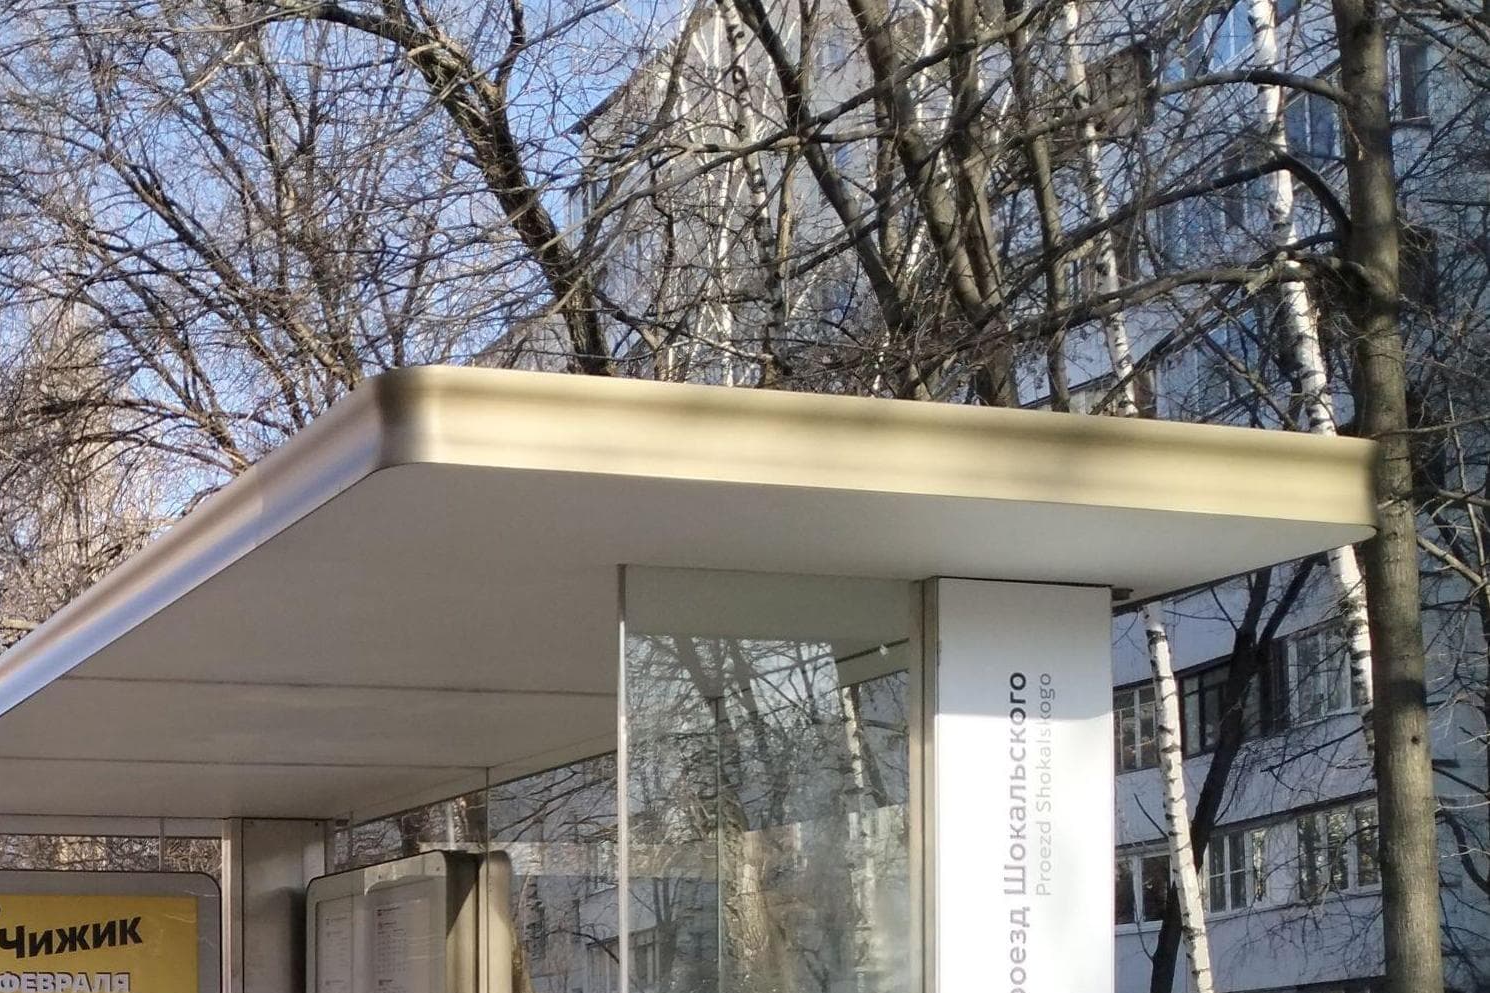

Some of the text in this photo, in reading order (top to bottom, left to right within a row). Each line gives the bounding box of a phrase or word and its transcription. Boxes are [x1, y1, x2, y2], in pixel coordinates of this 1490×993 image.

[1004, 672, 1028, 895] Шокальского
[1036, 672, 1055, 896] Proezd Shokalskogo
